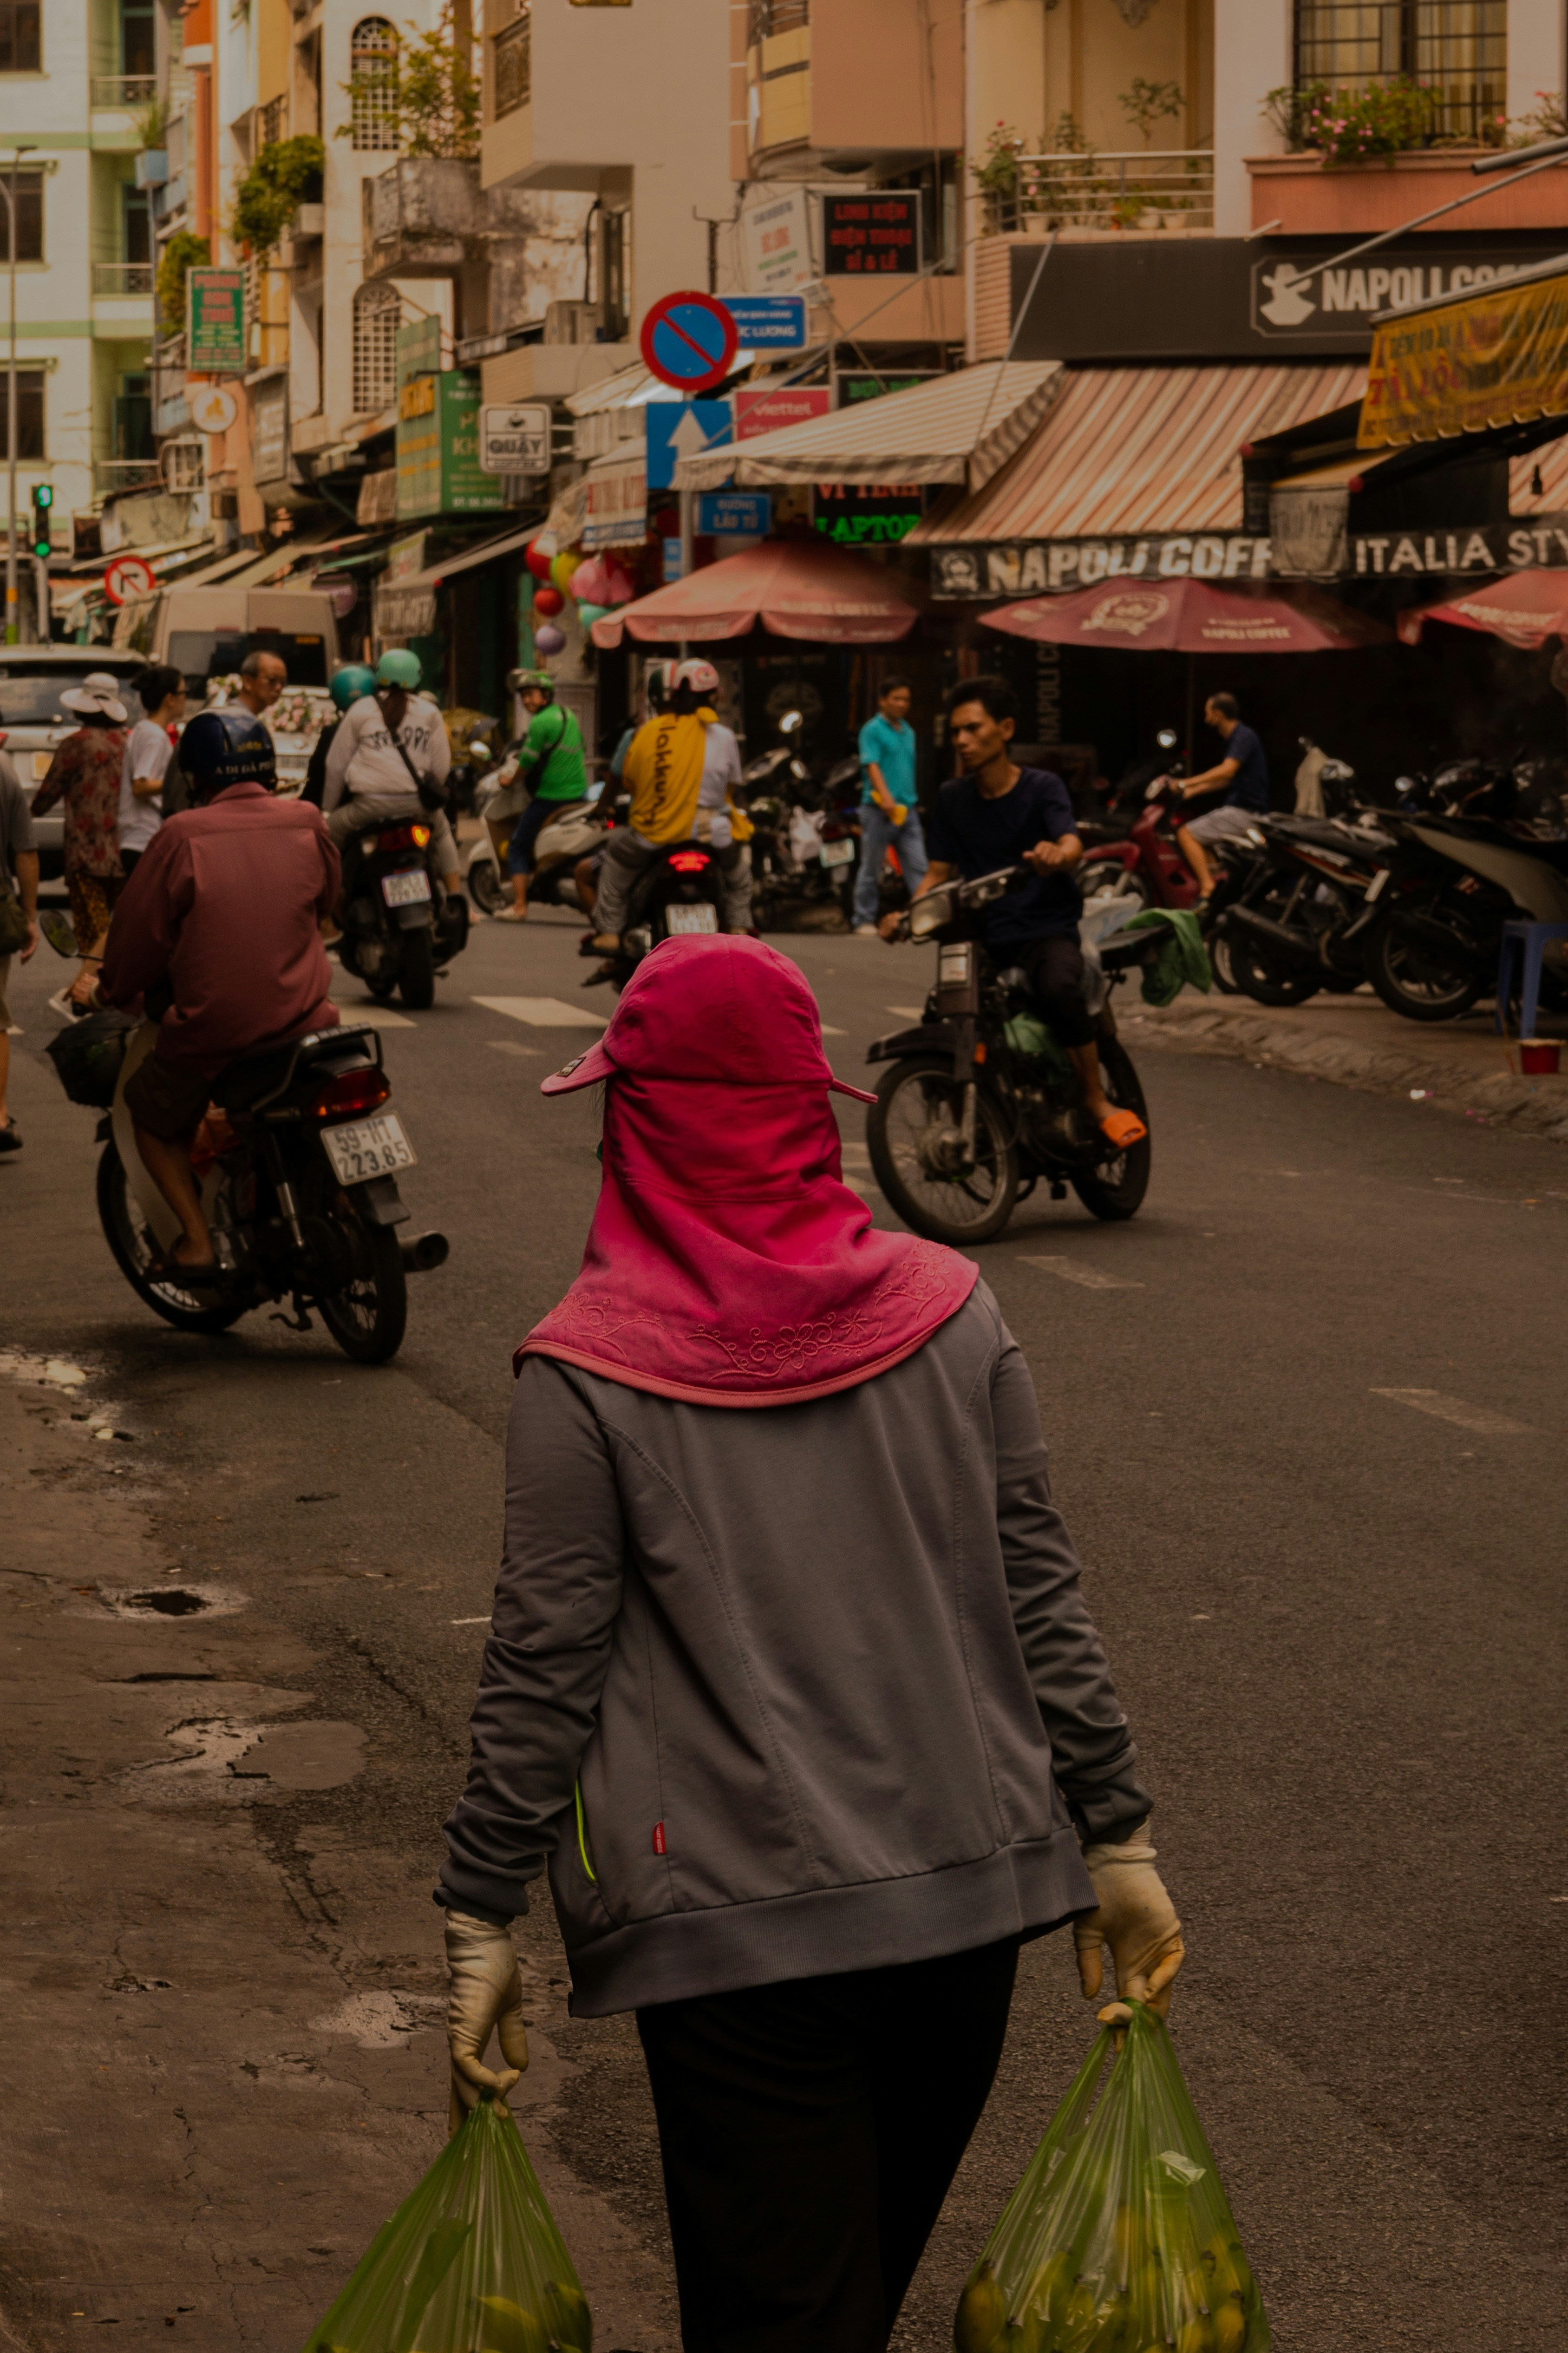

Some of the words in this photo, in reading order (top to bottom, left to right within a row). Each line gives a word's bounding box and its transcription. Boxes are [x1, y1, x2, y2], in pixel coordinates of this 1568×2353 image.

[1322, 266, 1443, 312] NAPOLI
[987, 540, 1149, 592] NAPOLI
[1158, 537, 1272, 577] COFF
[1355, 533, 1496, 574] ITALIA
[1202, 627, 1246, 639] NAPOLI
[1247, 626, 1291, 638] COFFEE
